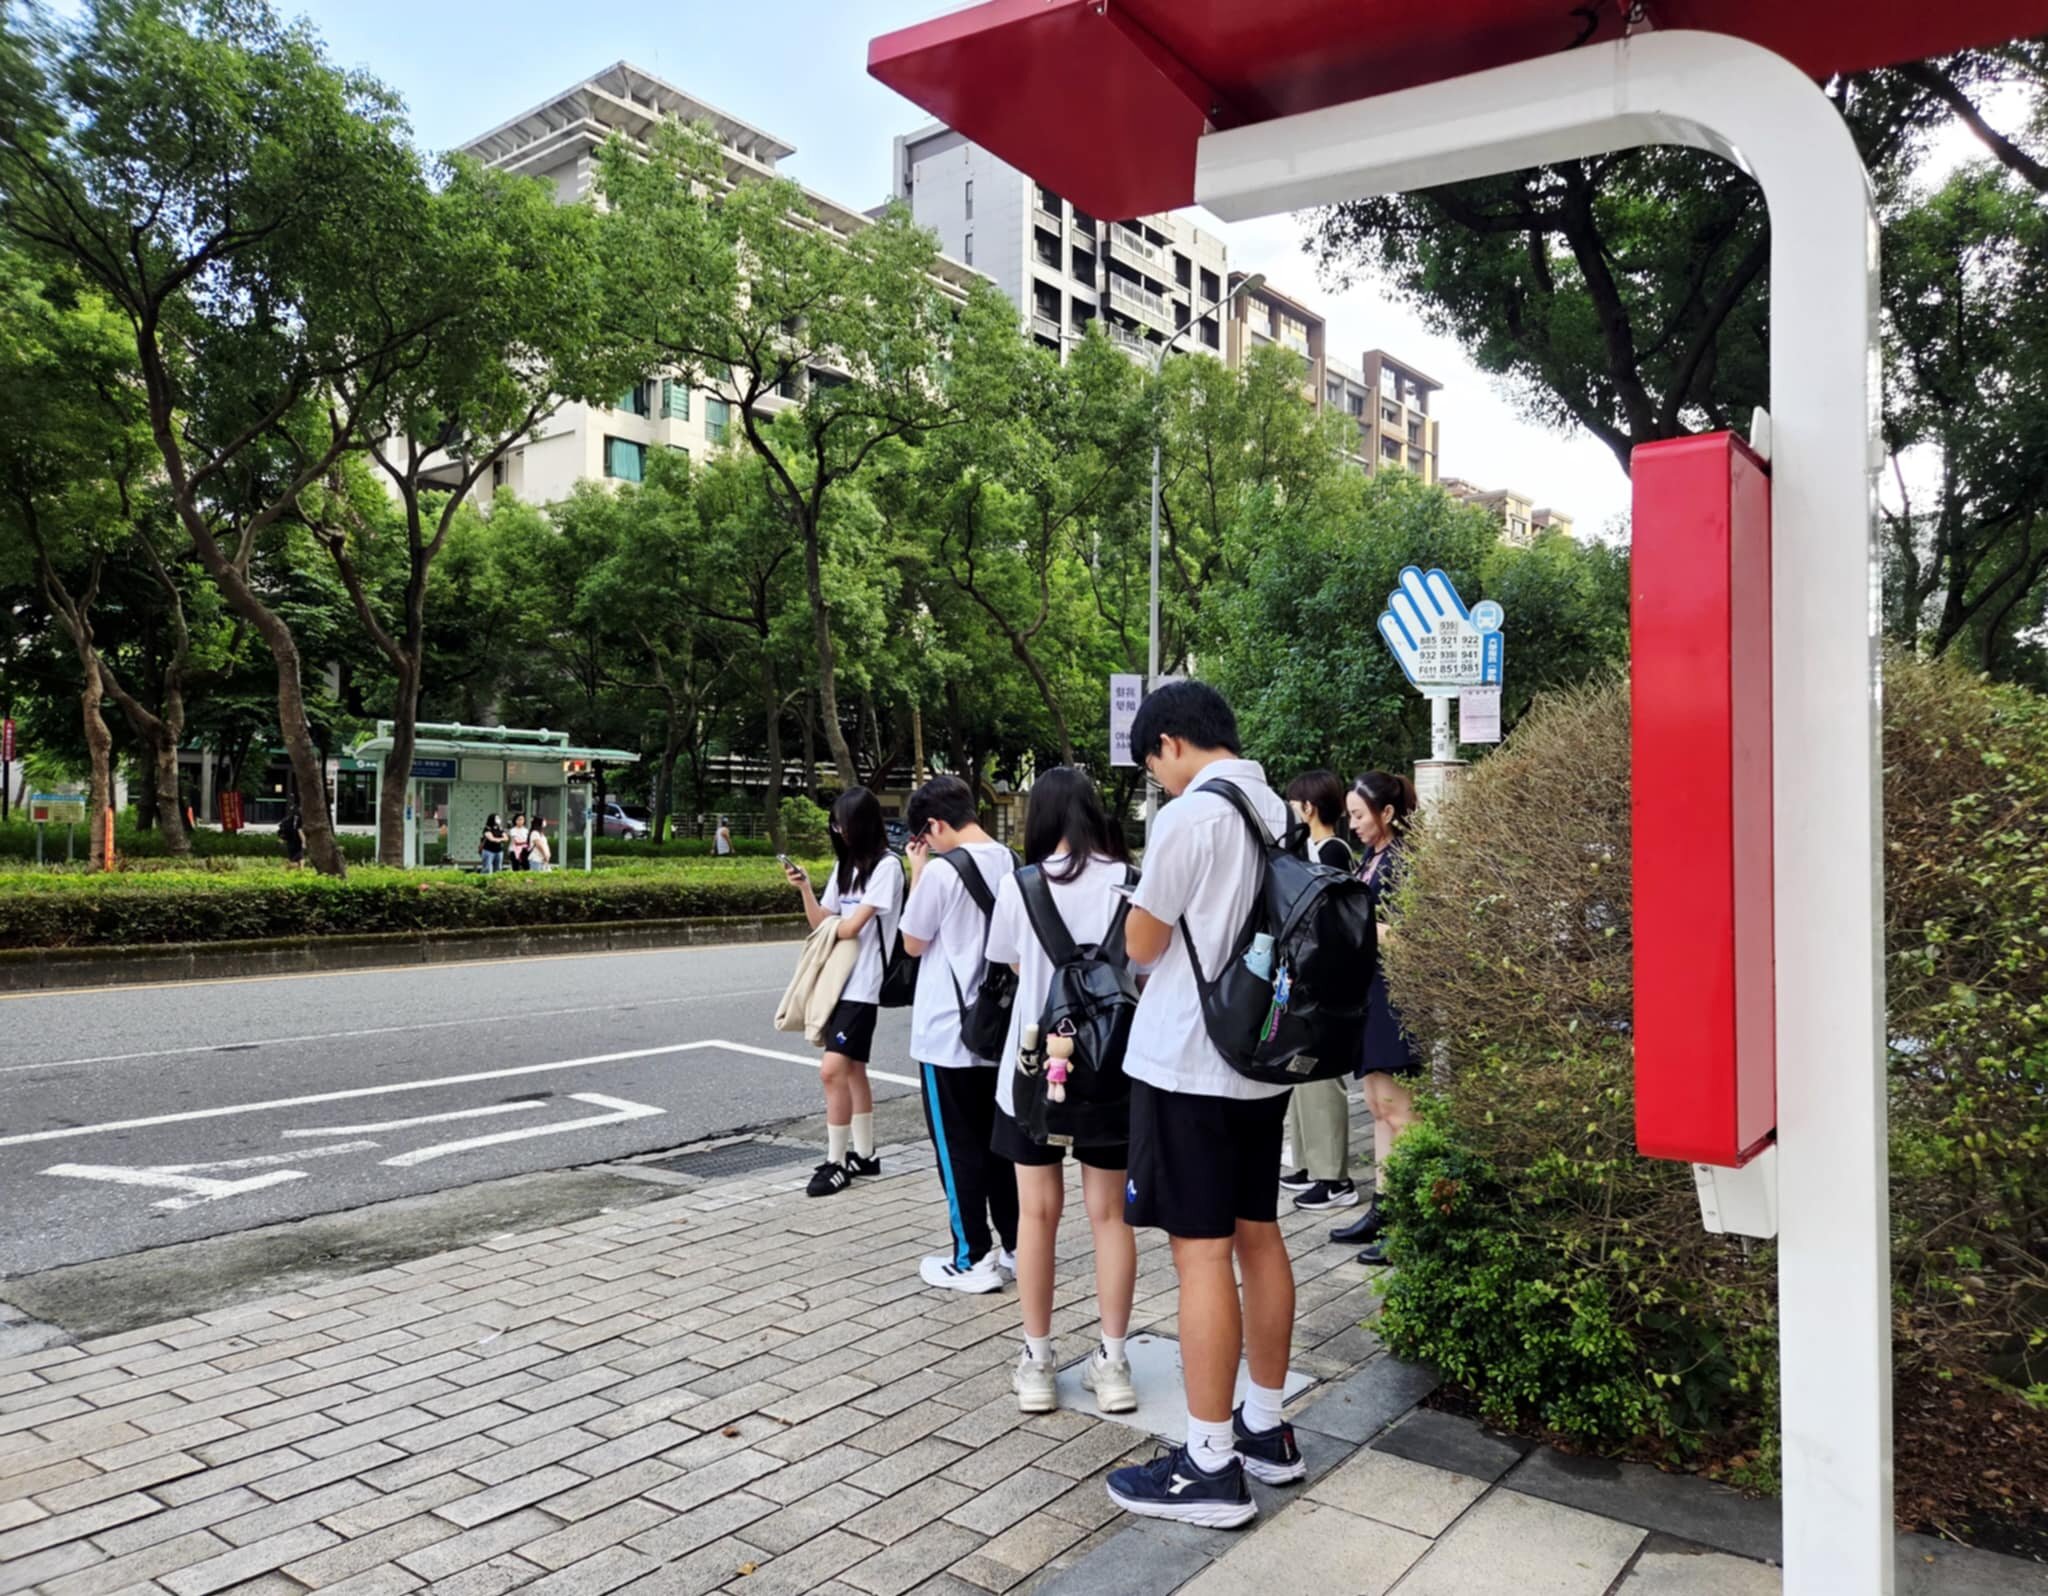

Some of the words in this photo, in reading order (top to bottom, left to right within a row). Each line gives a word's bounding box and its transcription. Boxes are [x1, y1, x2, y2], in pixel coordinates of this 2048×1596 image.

[1441, 636, 1457, 644] 921
[1462, 635, 1479, 644] 922
[1419, 651, 1436, 659] 932
[1461, 651, 1477, 659] 941
[1440, 664, 1457, 673] 851
[1461, 663, 1479, 672] 981
